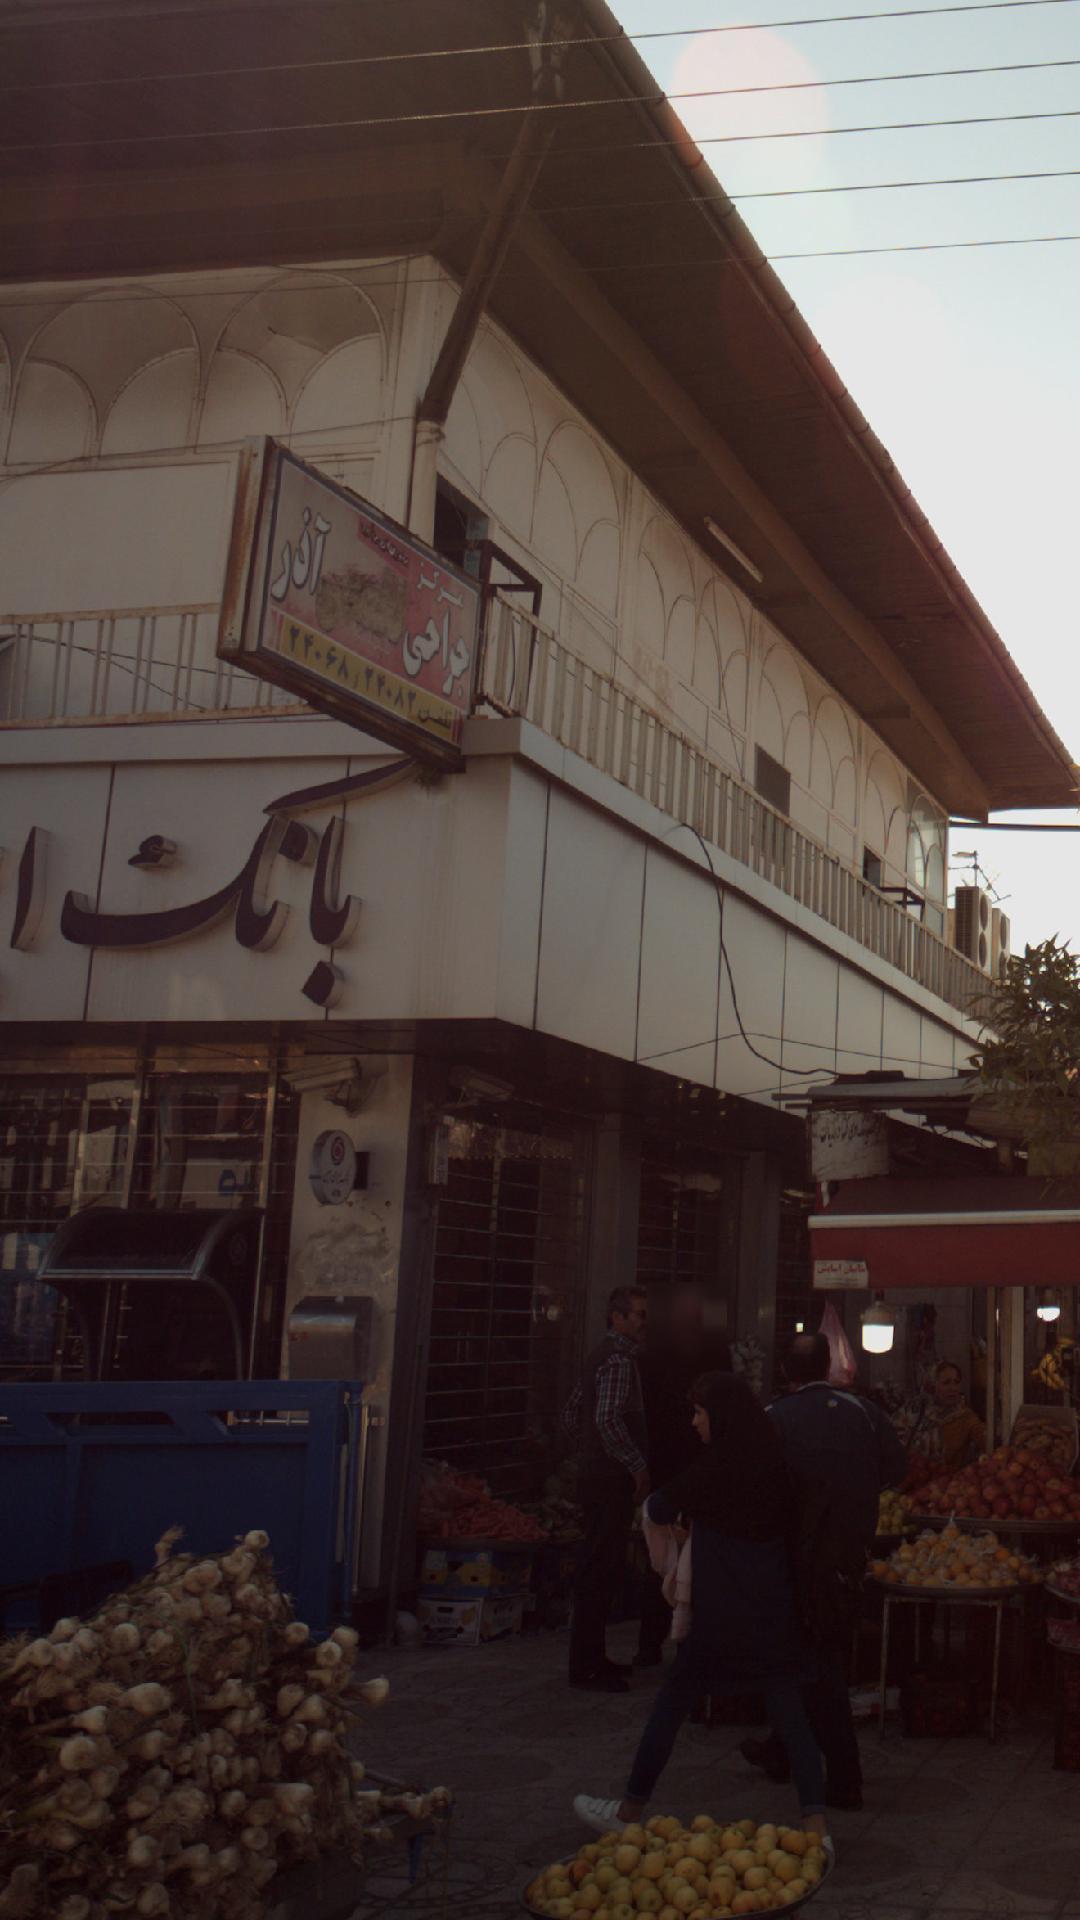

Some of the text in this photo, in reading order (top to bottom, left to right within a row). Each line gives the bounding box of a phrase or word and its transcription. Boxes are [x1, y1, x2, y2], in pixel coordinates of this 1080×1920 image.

[270, 506, 332, 600] آذر
[416, 561, 464, 608] مرکز
[402, 609, 470, 699] جراحی
[60, 756, 418, 1006] بانک
